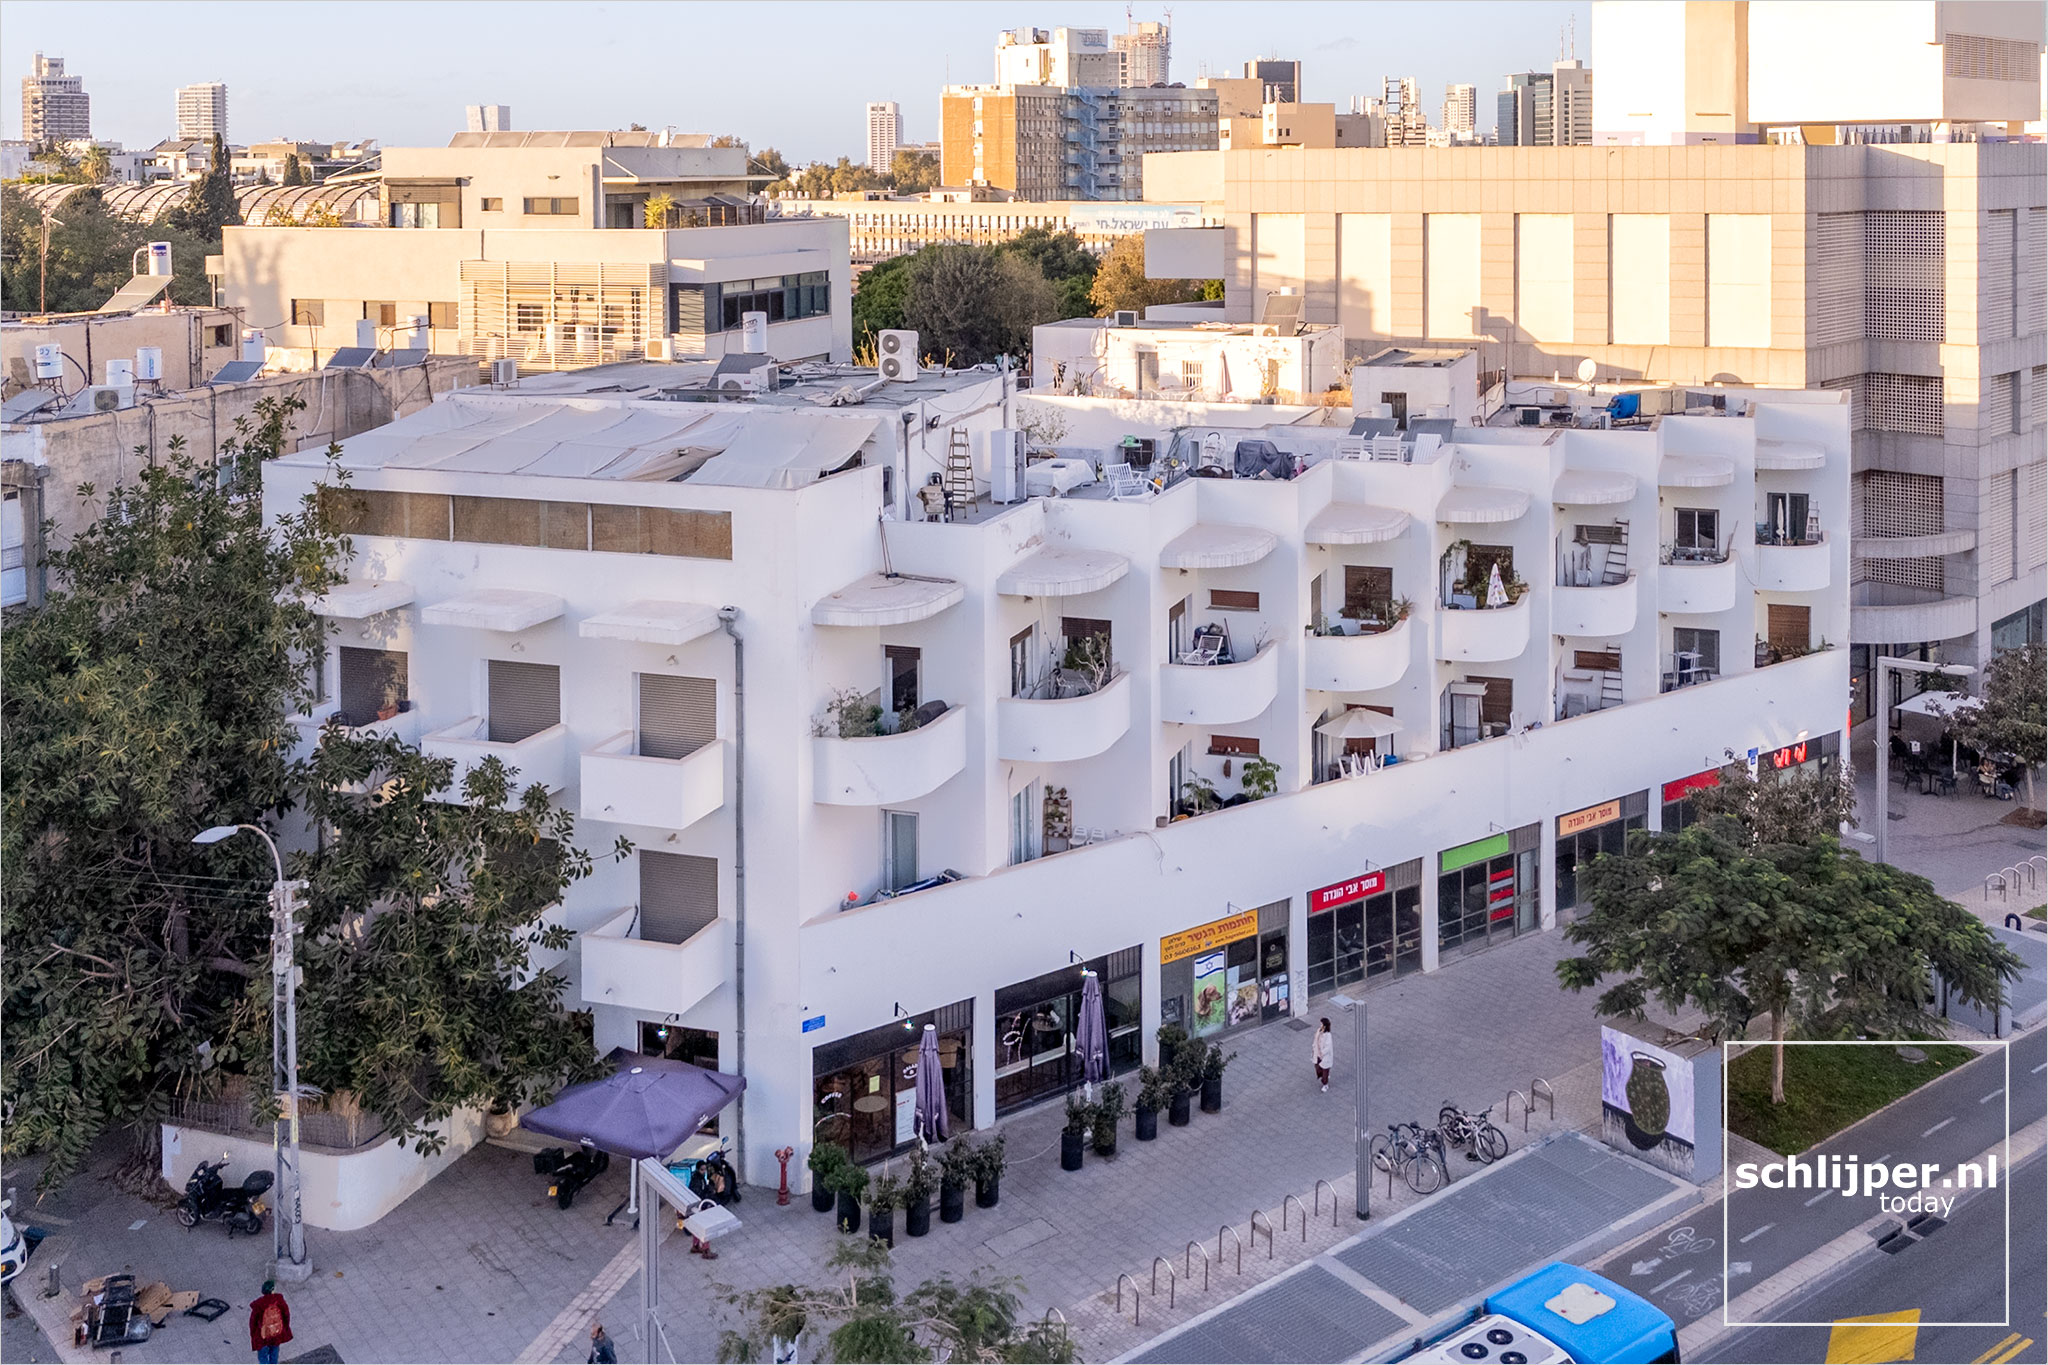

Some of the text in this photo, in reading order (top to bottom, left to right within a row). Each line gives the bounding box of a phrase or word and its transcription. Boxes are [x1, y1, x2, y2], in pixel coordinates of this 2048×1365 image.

[1096, 218, 1109, 230] חי
[1111, 217, 1148, 230] ישראל
[1152, 219, 1169, 229] עם
[1568, 808, 1612, 828] מוסך אבי הונדה
[1323, 877, 1378, 903] מוסך אבי הונדה
[1187, 914, 1255, 942] חותמות הגשר
